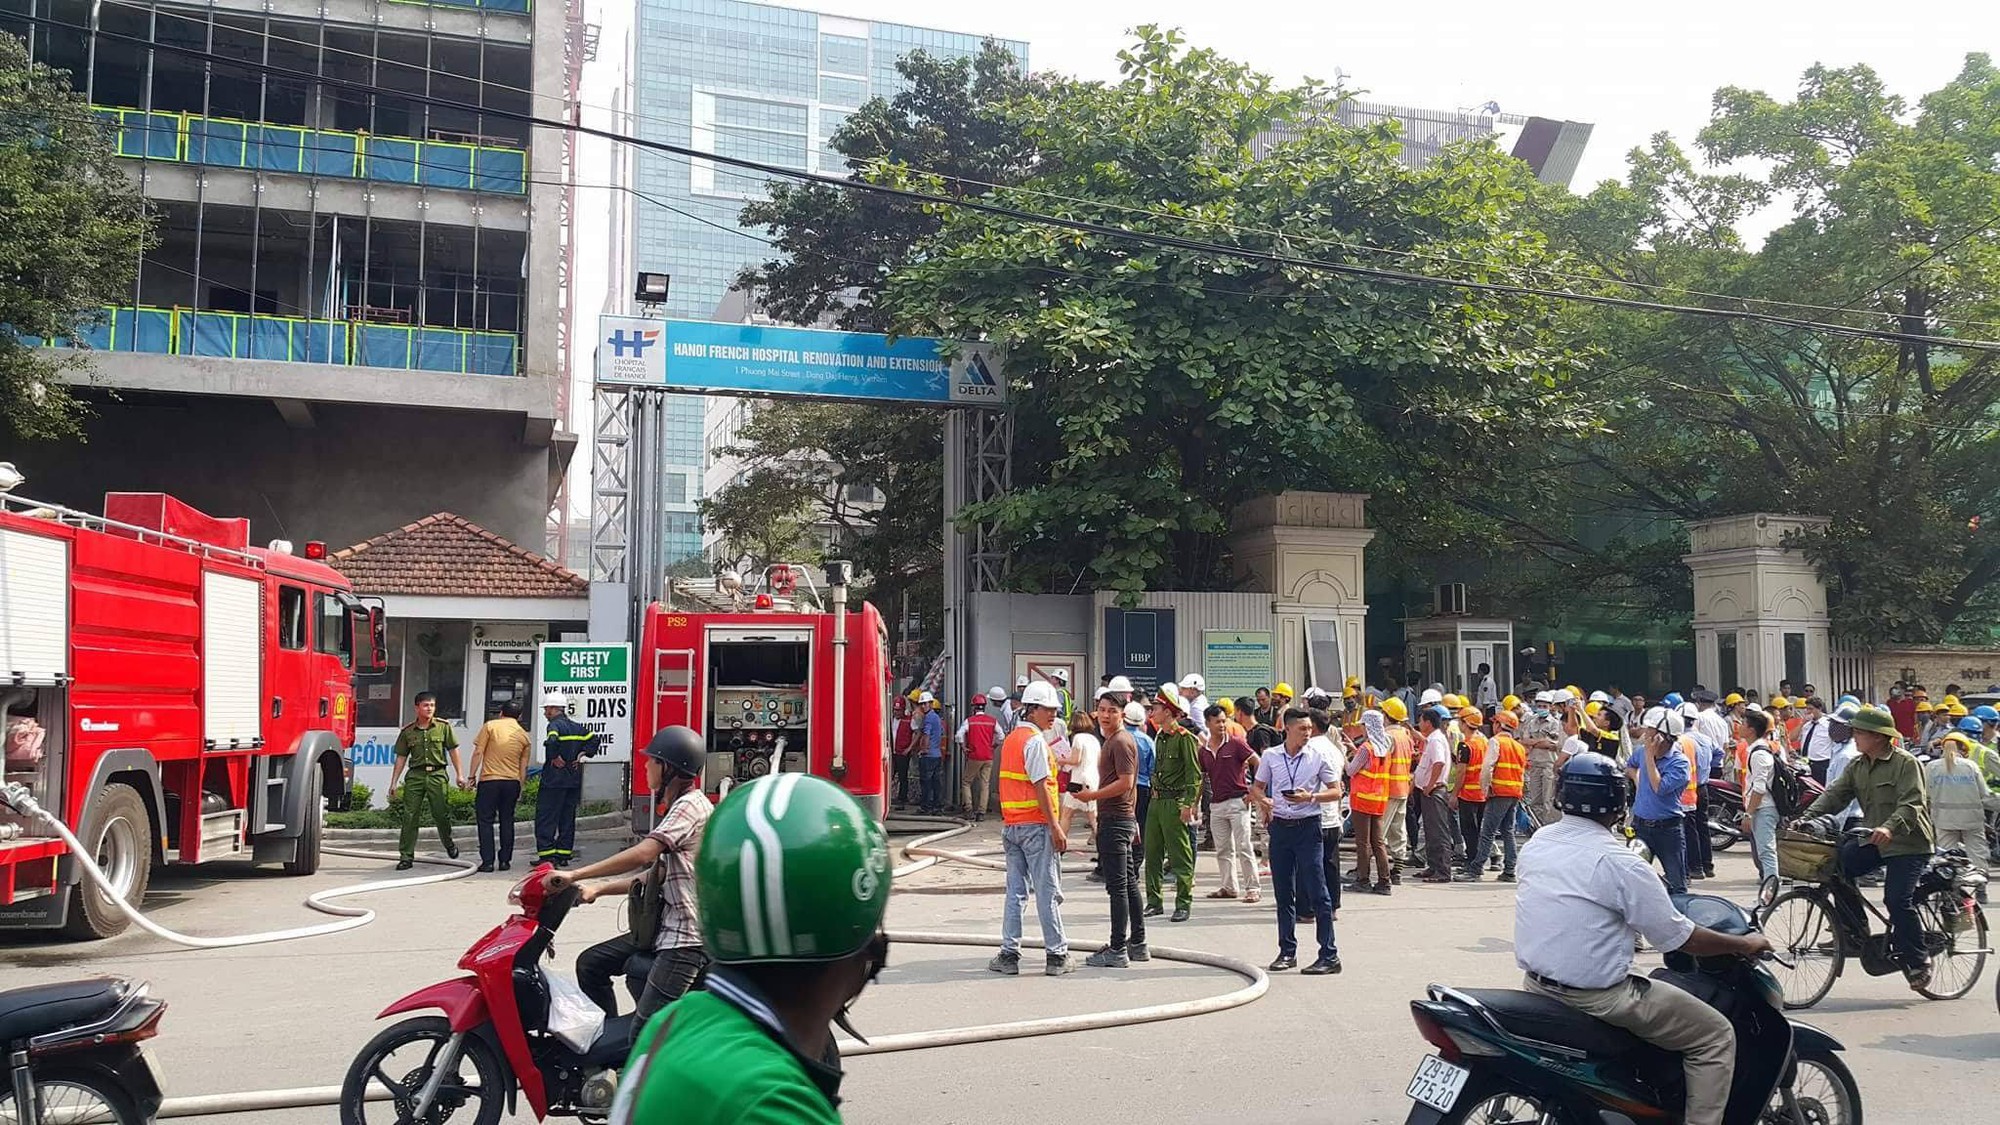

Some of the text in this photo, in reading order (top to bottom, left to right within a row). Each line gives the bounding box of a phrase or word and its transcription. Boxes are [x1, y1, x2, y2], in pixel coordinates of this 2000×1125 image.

[673, 342, 943, 373] HANOI FRENCH HOSPITAL RENOVATION AND EXTENSION
[958, 385, 997, 396] DELTA
[667, 616, 687, 627] PS2
[474, 638, 533, 648] Vietcombank
[561, 651, 611, 665] SAFETY
[1130, 653, 1151, 662] HBP
[570, 666, 601, 678] FIRST
[543, 685, 627, 695] WE HAVE WORKED
[587, 698, 627, 718] DAYS
[579, 722, 606, 733] HOUT
[1423, 1059, 1461, 1087] 29-B1
[1410, 1076, 1454, 1109] 775.20
